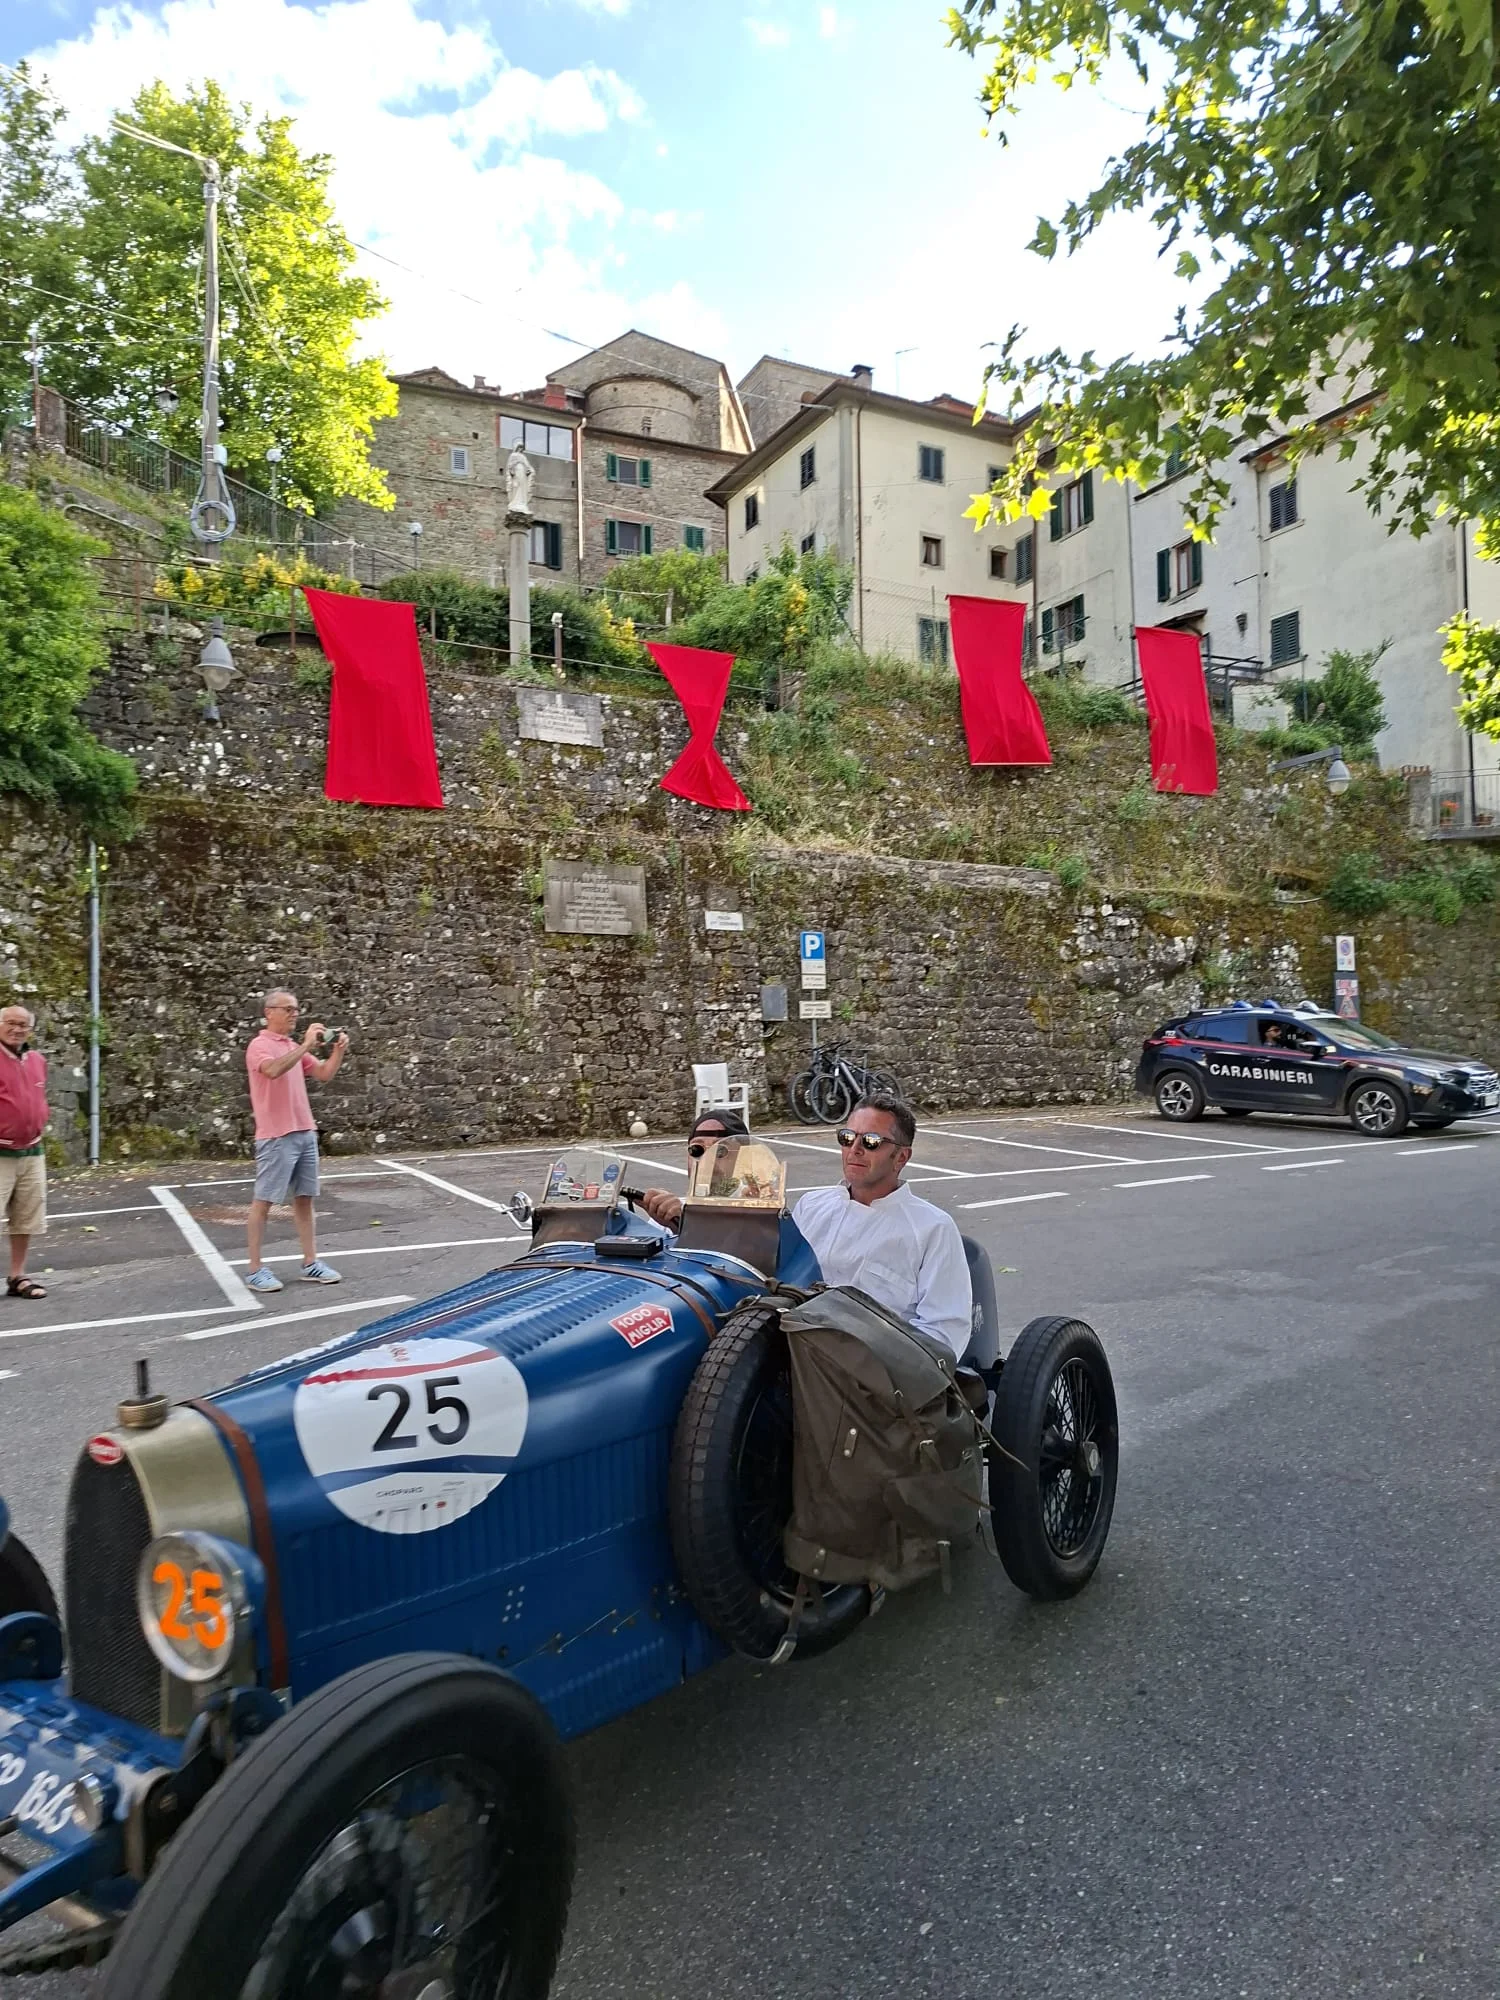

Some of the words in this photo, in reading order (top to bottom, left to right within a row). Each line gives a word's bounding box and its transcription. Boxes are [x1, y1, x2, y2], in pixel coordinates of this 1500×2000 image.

[805, 934, 820, 957] P
[1209, 1063, 1314, 1085] CARABINIERI
[618, 1308, 652, 1328] 1000
[627, 1317, 667, 1342] MIGLIA
[367, 1375, 470, 1452] 25
[152, 1560, 228, 1650] 25
